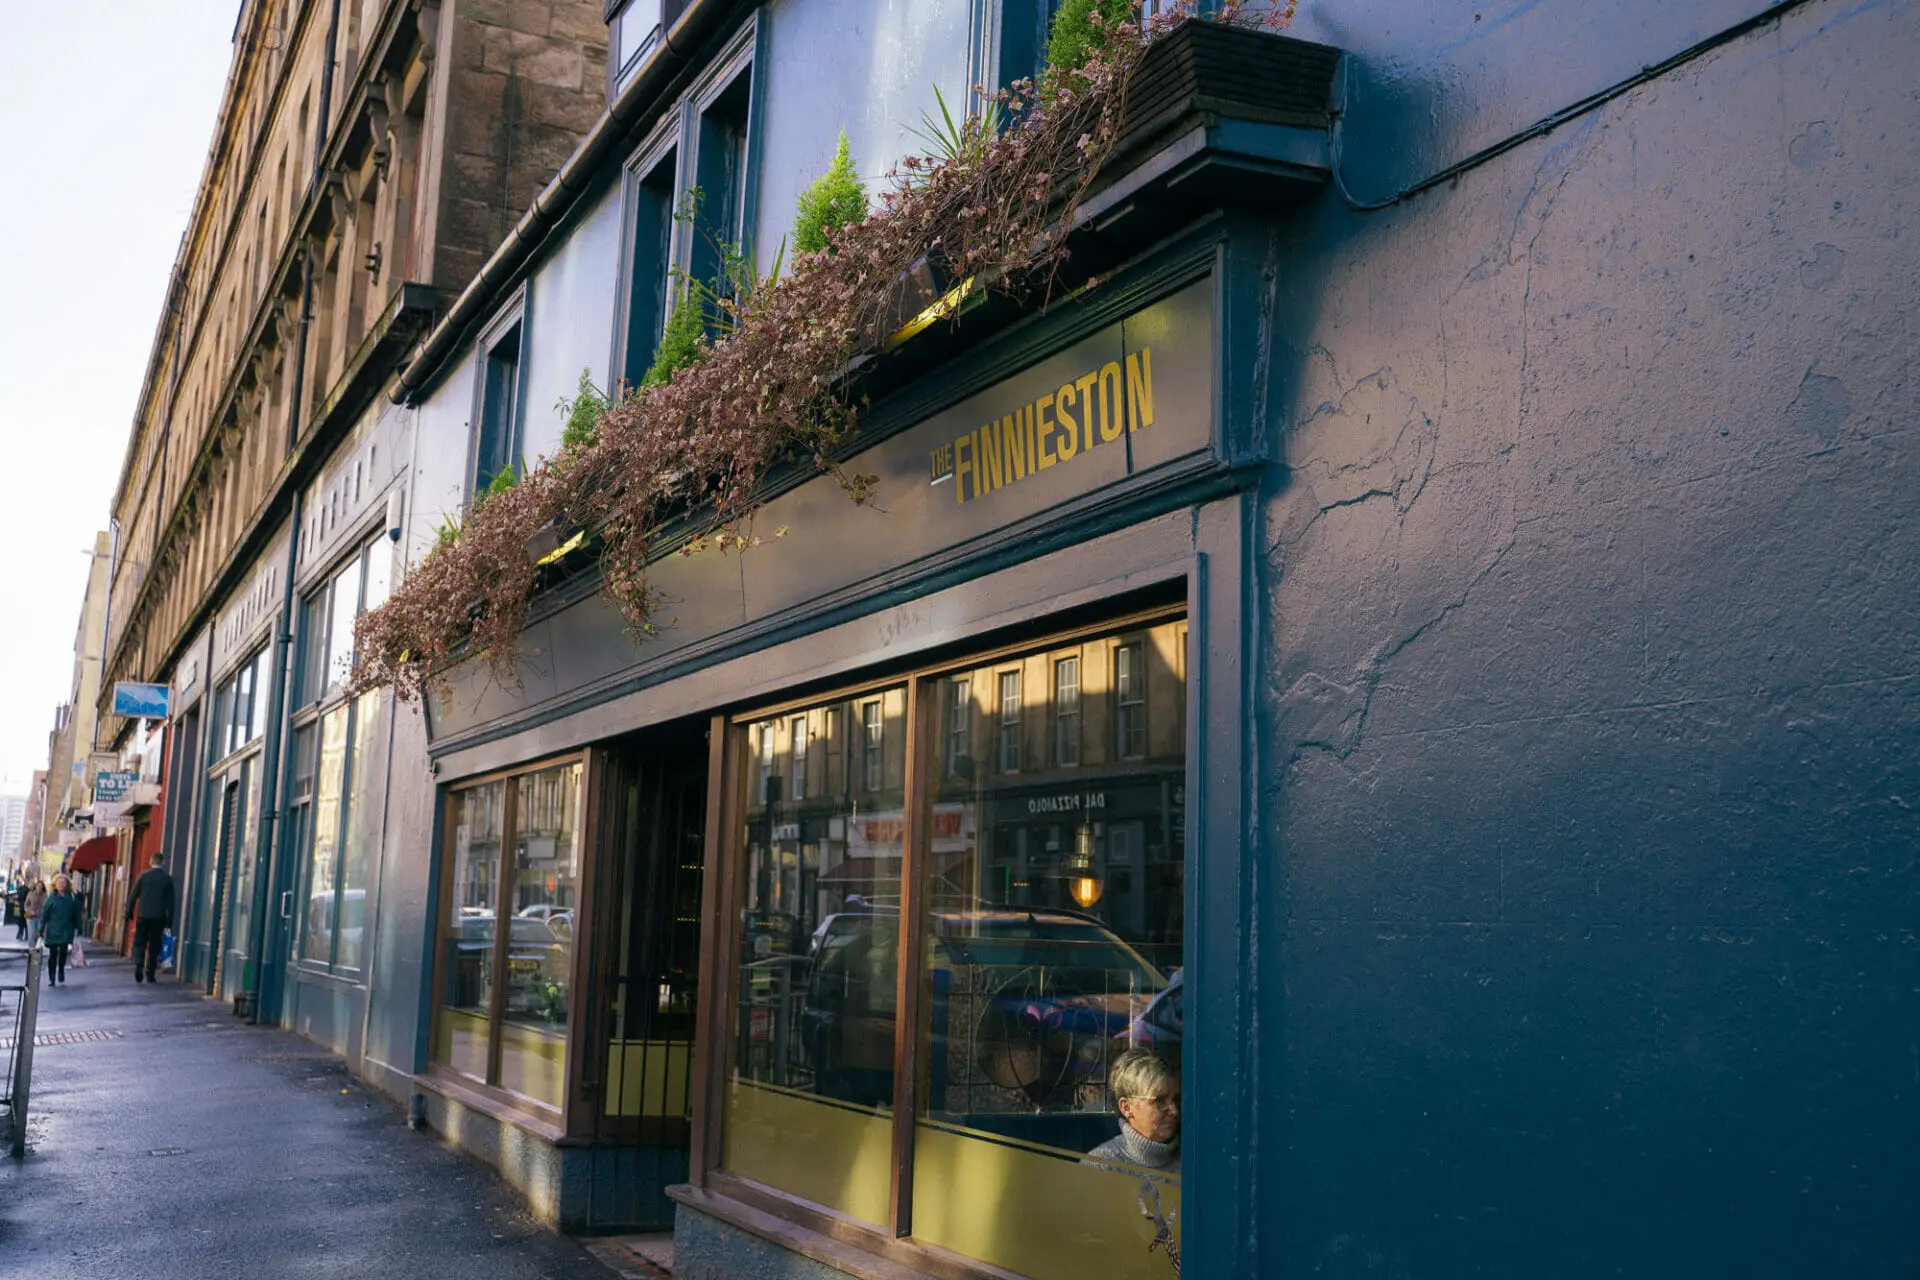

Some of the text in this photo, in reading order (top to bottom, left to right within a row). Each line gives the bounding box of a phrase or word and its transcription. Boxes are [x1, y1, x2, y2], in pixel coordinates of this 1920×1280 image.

[931, 347, 1154, 505] THE FINNIESTON
[99, 779, 115, 788] TO
